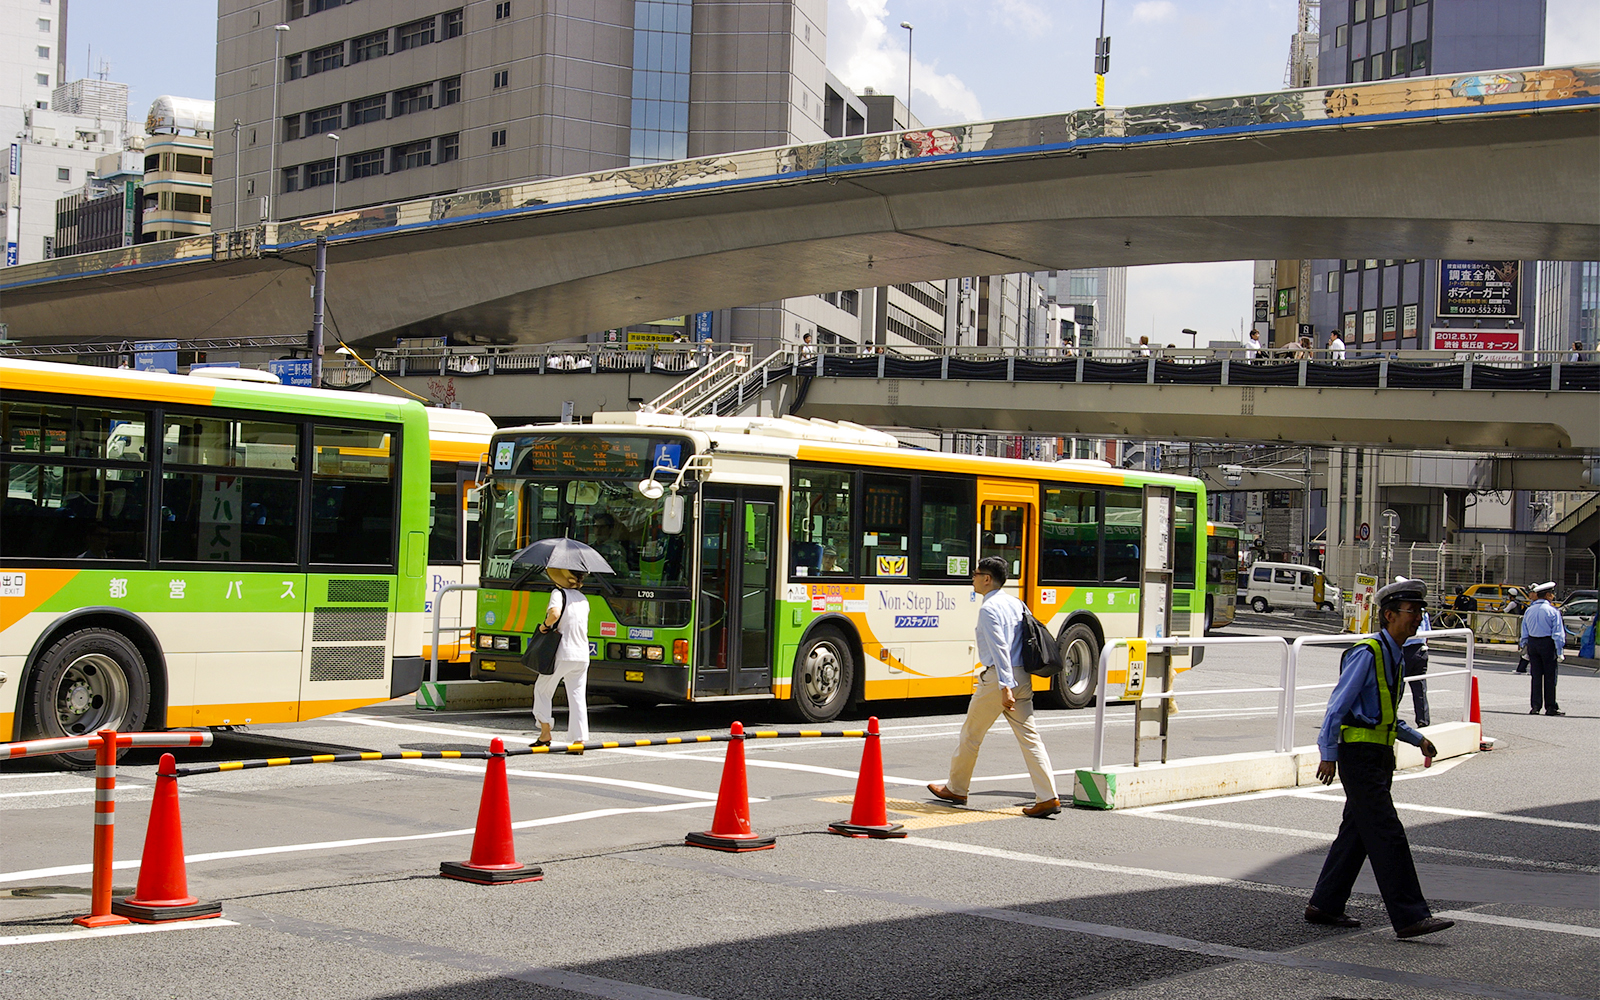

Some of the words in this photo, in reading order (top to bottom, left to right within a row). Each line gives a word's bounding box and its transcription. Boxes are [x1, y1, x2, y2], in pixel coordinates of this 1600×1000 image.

[1448, 270, 1496, 281] 調査全般
[1448, 287, 1511, 298] ボディーガード
[1459, 306, 1507, 314] 0120-552-783
[1444, 341, 1460, 349] 渋谷
[1461, 341, 1485, 349] 桜丘店
[1486, 342, 1518, 350] オープン
[2, 575, 23, 587] 出口
[109, 577, 296, 599] 都営バス
[637, 591, 655, 599] L703
[936, 591, 956, 610] Bus
[895, 616, 939, 627] ノンステップバス
[1130, 662, 1143, 670] TAXI
